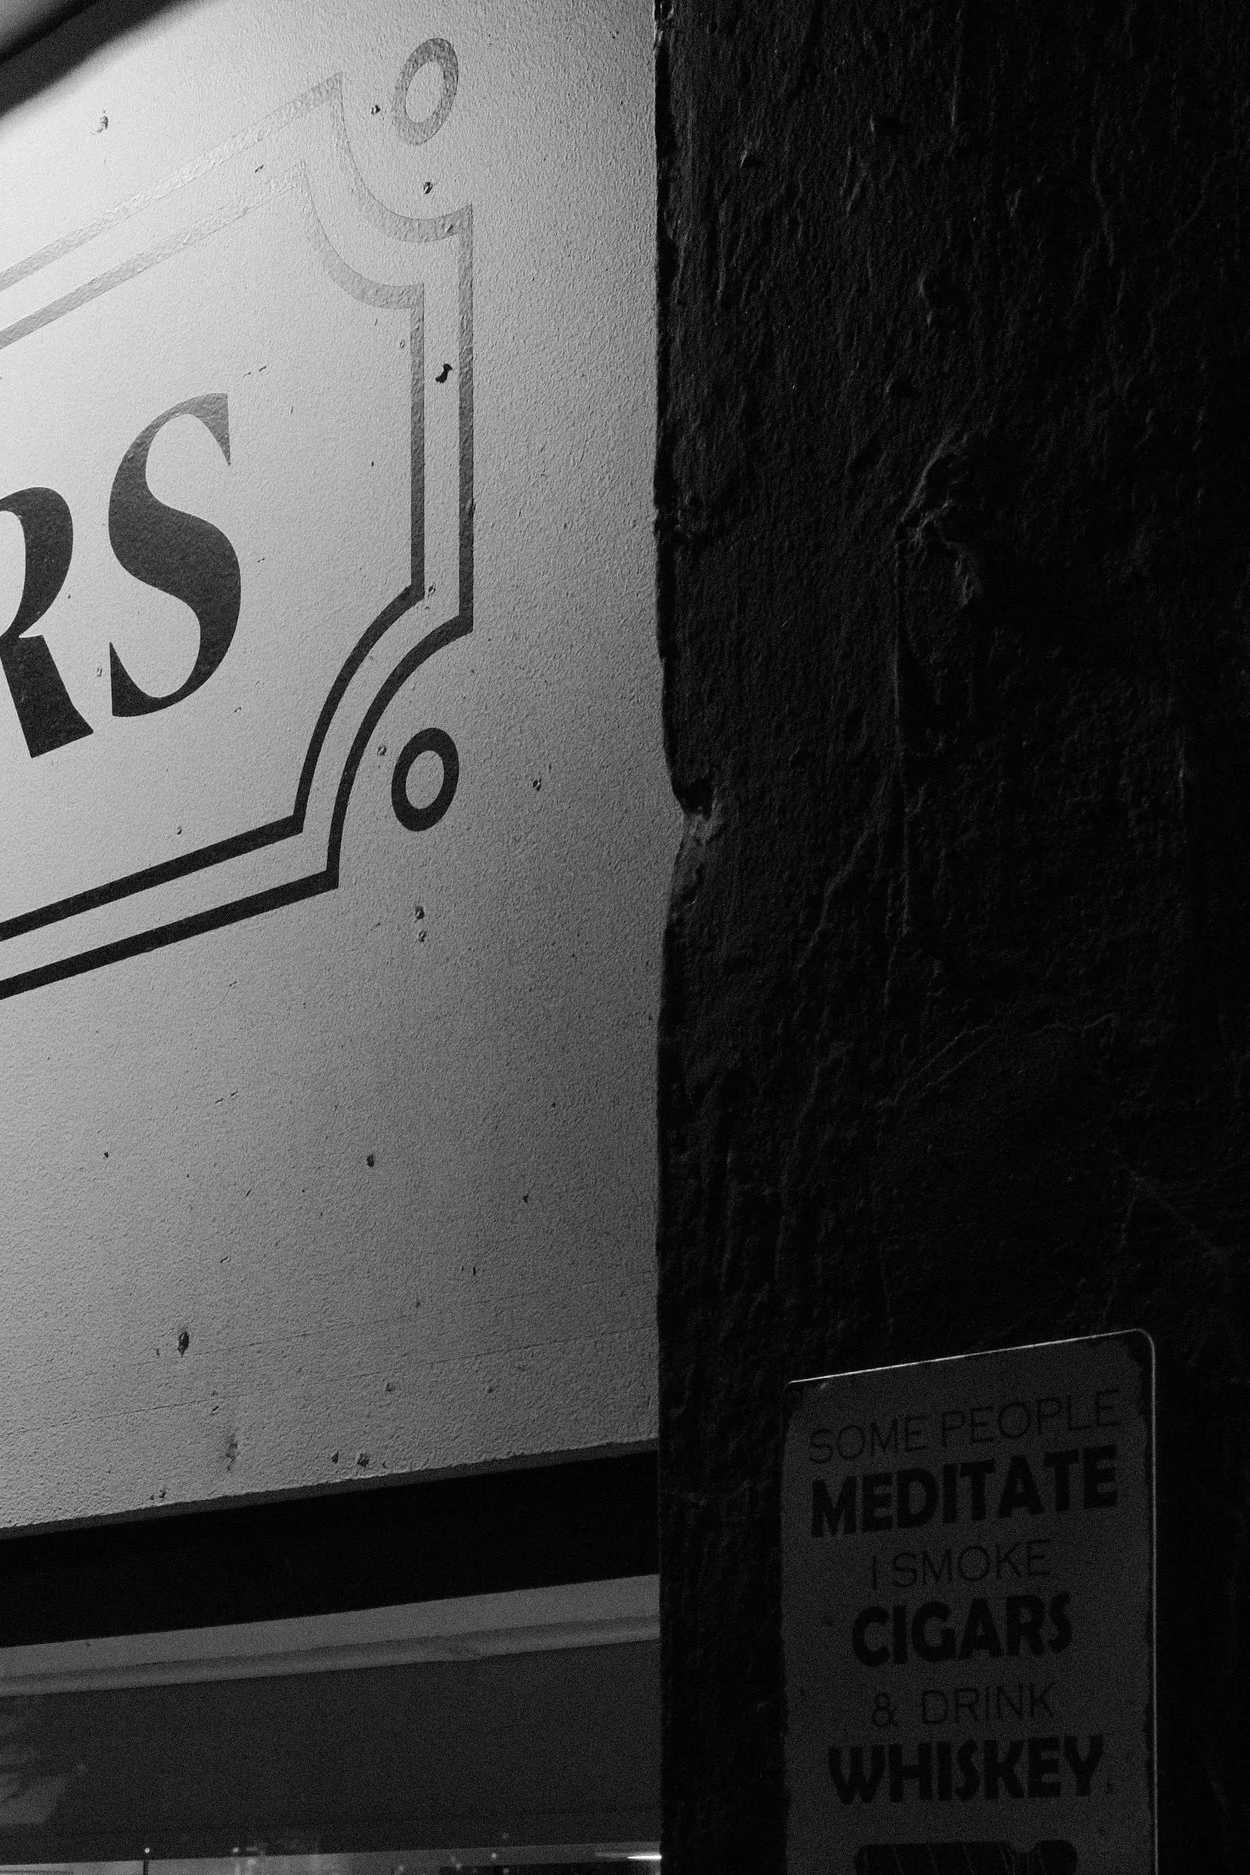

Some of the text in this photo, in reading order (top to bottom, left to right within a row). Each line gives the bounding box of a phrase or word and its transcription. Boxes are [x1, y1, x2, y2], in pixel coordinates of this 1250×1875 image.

[809, 1389, 1122, 1464] SOME PEOPLE
[811, 1444, 1118, 1537] MEDITATE
[871, 1539, 1052, 1590] I SMOKE
[852, 1591, 1073, 1667] CIGARS
[871, 1681, 1056, 1728] & DRINK
[828, 1735, 1104, 1805] WHISKEY
